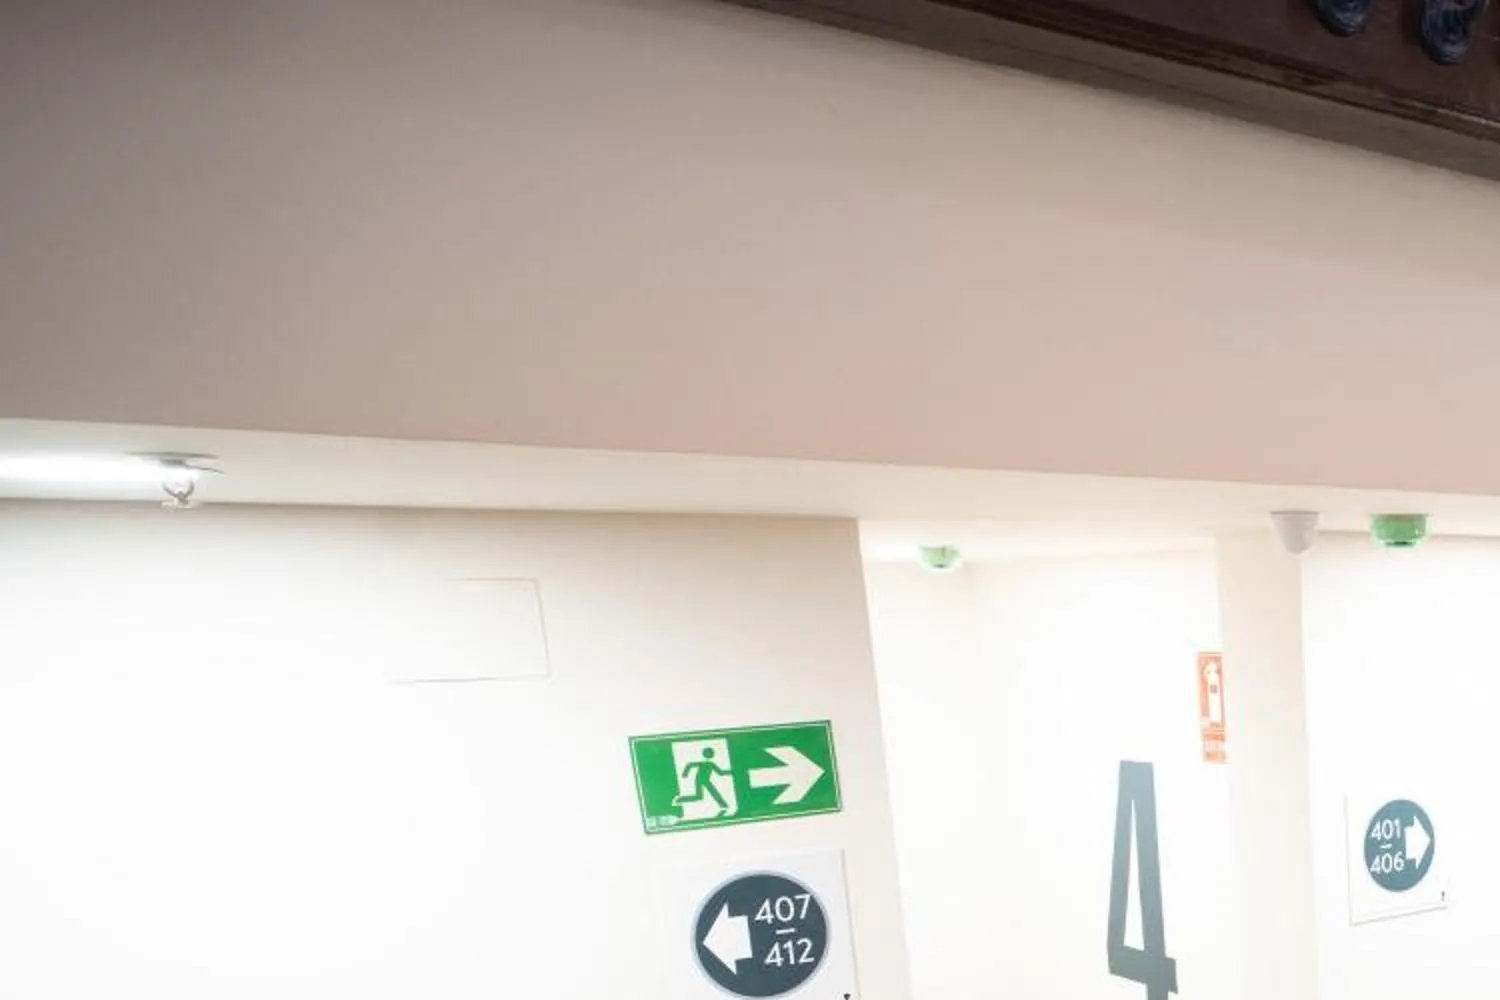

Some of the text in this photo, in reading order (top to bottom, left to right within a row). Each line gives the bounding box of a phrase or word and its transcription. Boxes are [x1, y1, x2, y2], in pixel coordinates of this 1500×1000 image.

[1370, 818, 1402, 841] 401
[1369, 851, 1405, 874] 406
[754, 893, 812, 924] 407
[764, 937, 815, 967] 412
